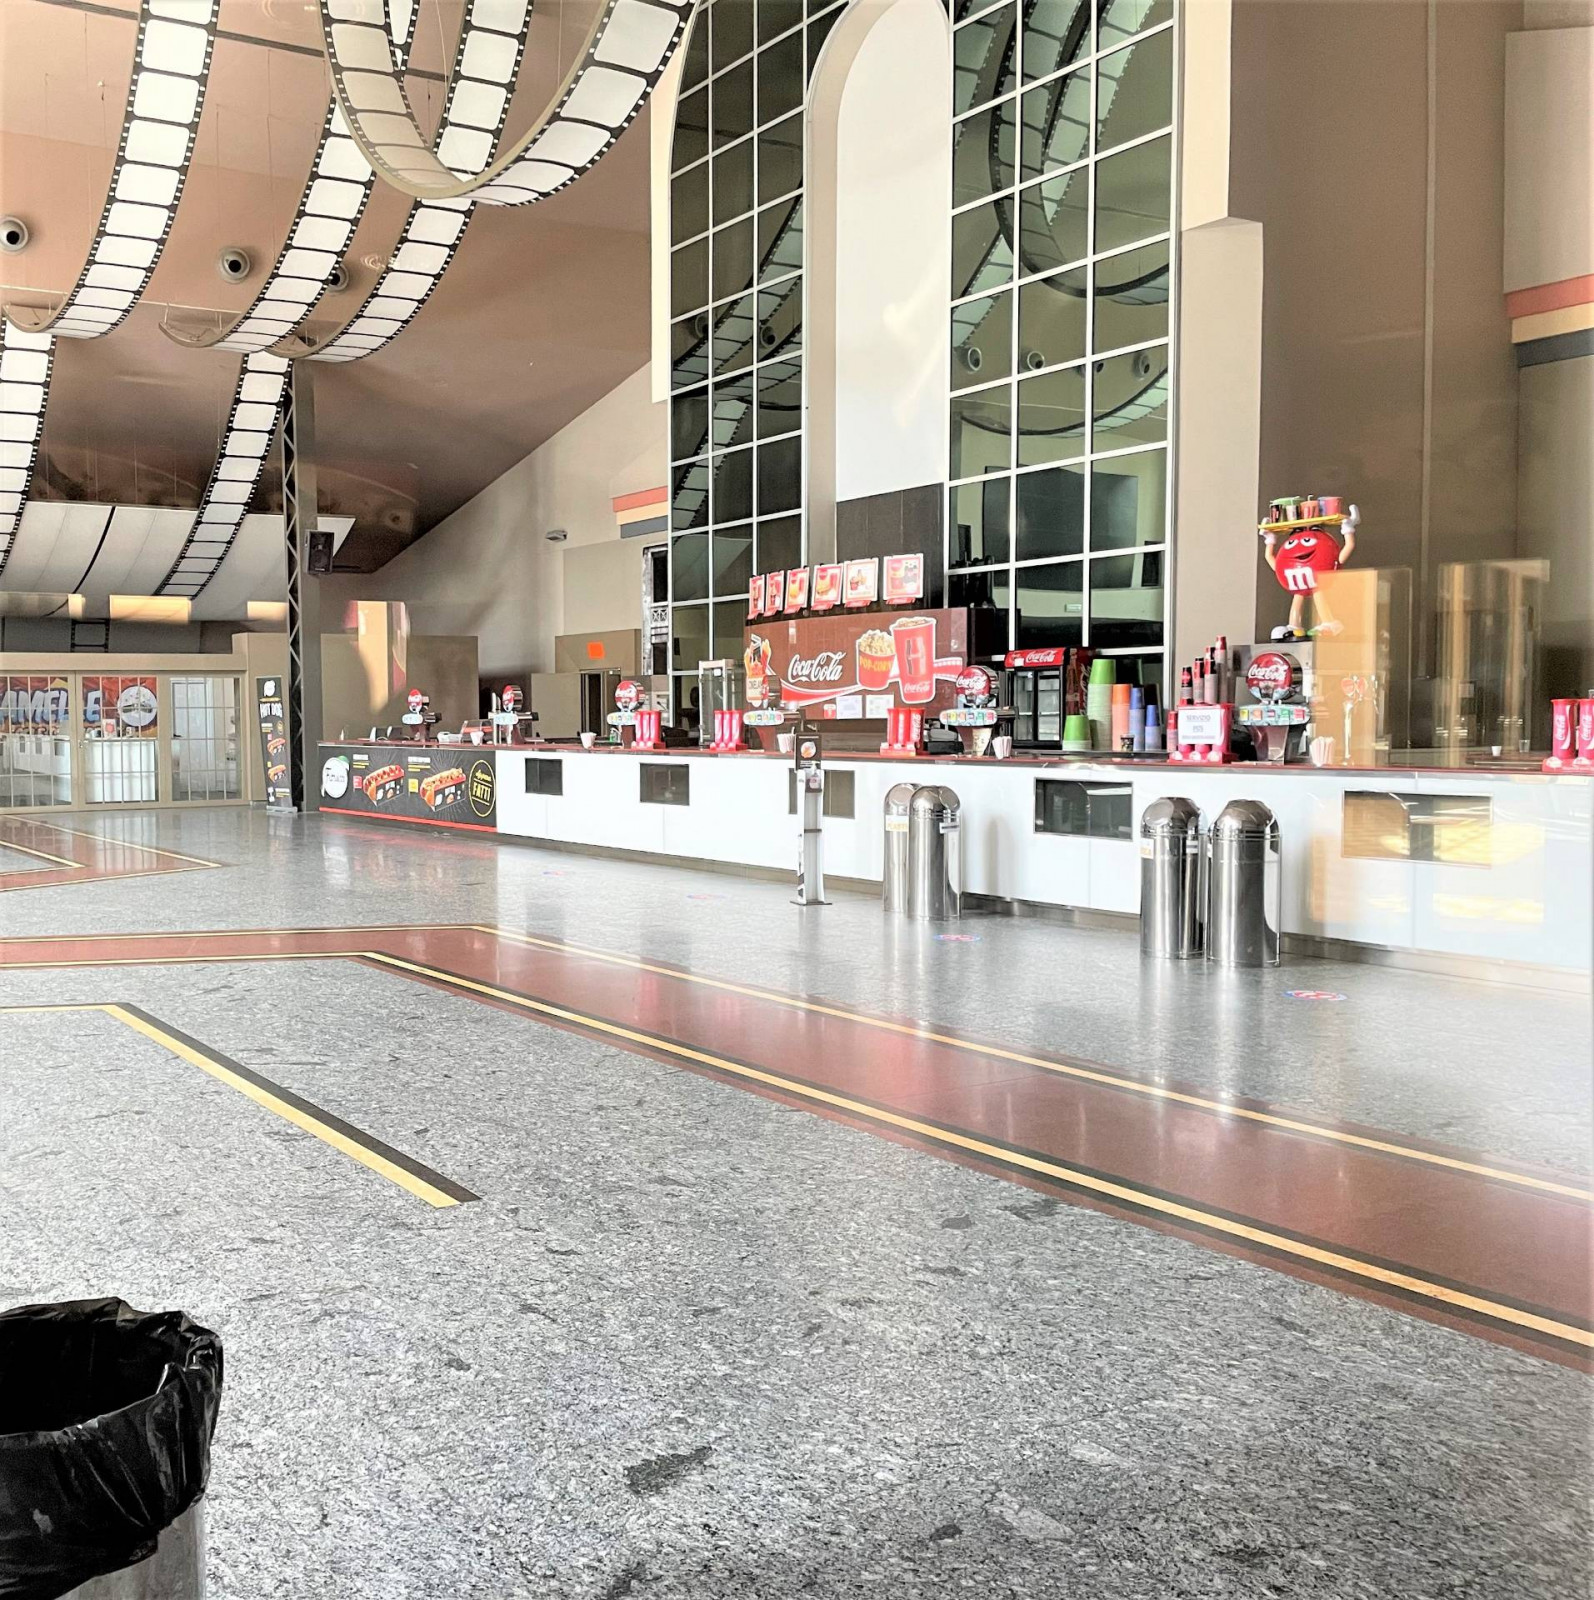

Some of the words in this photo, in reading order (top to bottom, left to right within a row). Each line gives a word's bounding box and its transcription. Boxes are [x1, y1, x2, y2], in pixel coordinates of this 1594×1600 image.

[1026, 650, 1057, 663] Coca-Cola
[787, 651, 847, 683] Coca-Cola
[1247, 664, 1290, 681] Coca-Cola
[956, 675, 988, 690] Coca-Cola
[472, 782, 491, 801] FATTI
